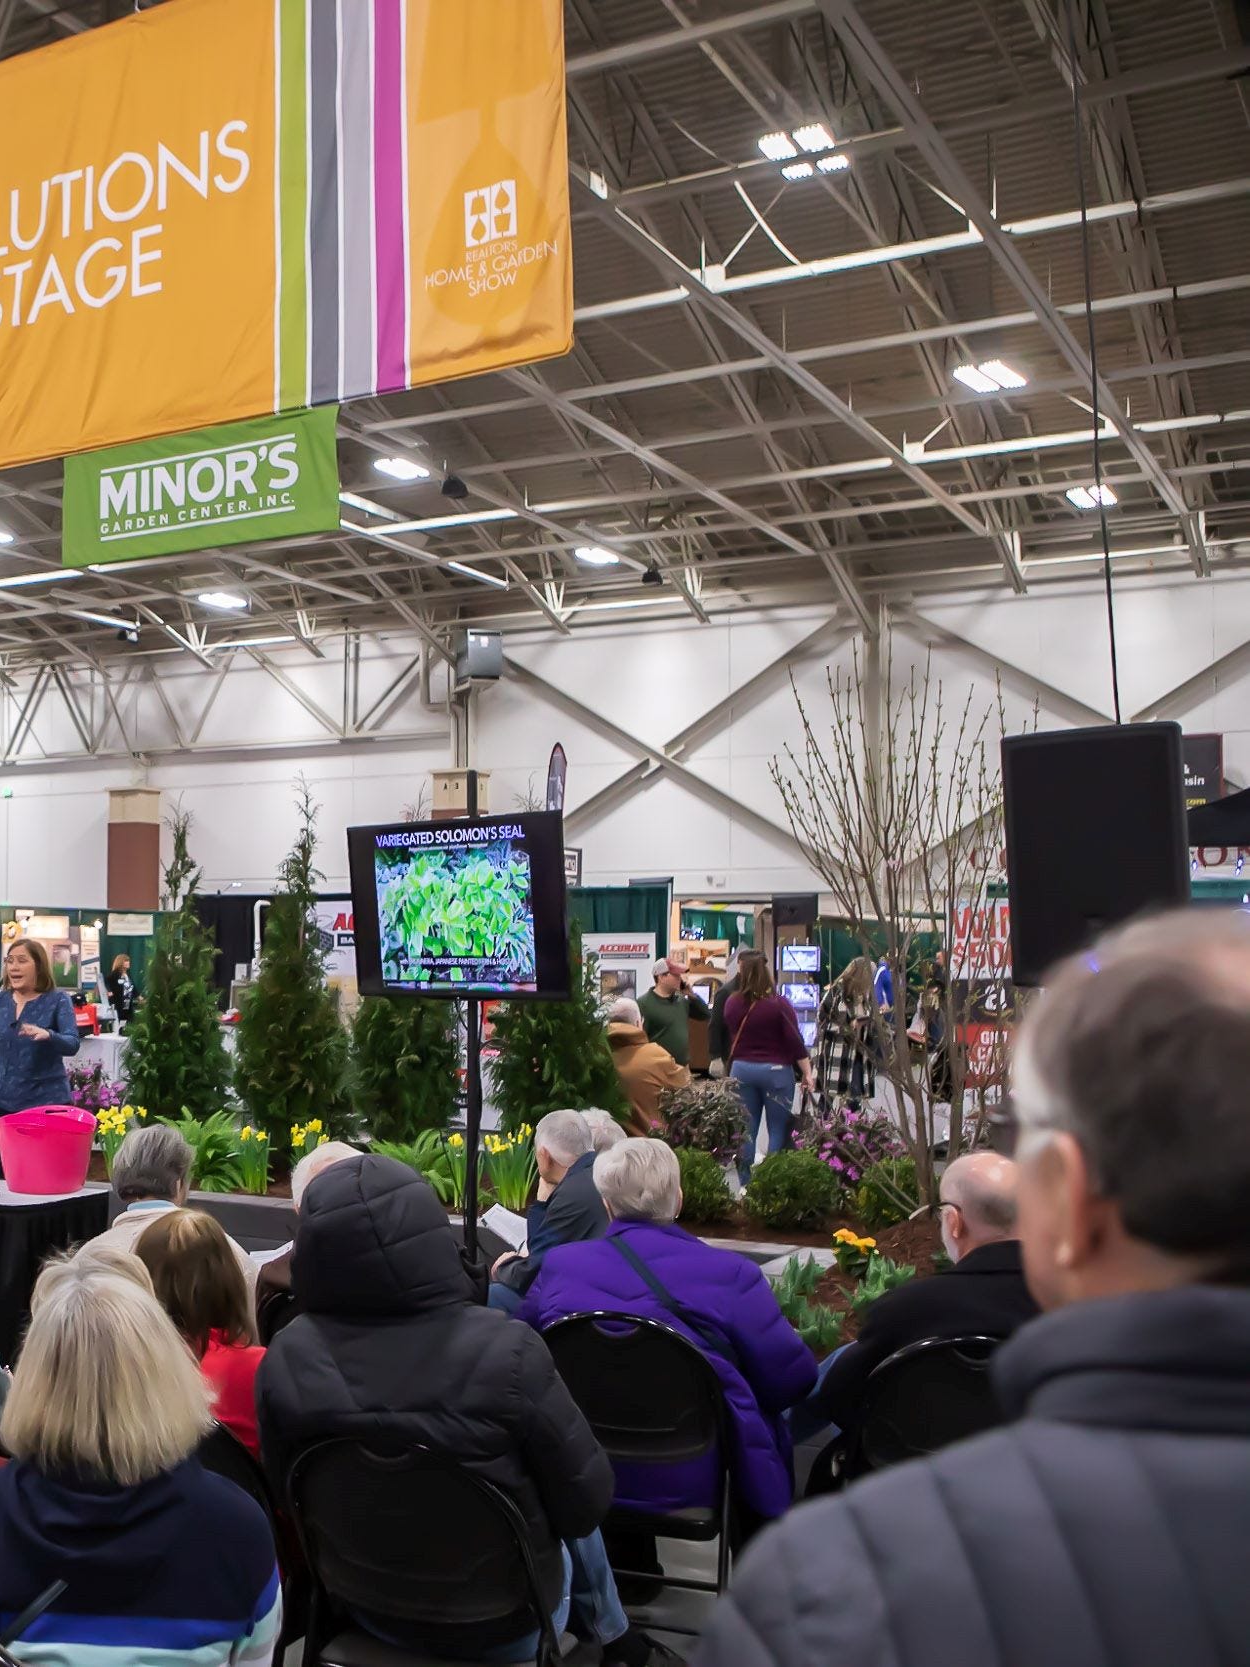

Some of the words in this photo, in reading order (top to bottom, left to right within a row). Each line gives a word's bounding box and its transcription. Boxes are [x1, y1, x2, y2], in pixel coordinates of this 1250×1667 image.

[424, 265, 473, 291] HOME
[478, 260, 487, 277] &
[492, 239, 558, 273] GARDEN
[468, 270, 518, 297] SHOW
[100, 441, 300, 519] MINOR'S
[100, 513, 169, 534] GARDEN
[259, 492, 295, 508] INC.
[375, 833, 434, 847] VARIEGATED
[435, 827, 497, 843] SOLOMON'S
[498, 825, 525, 839] SEAL
